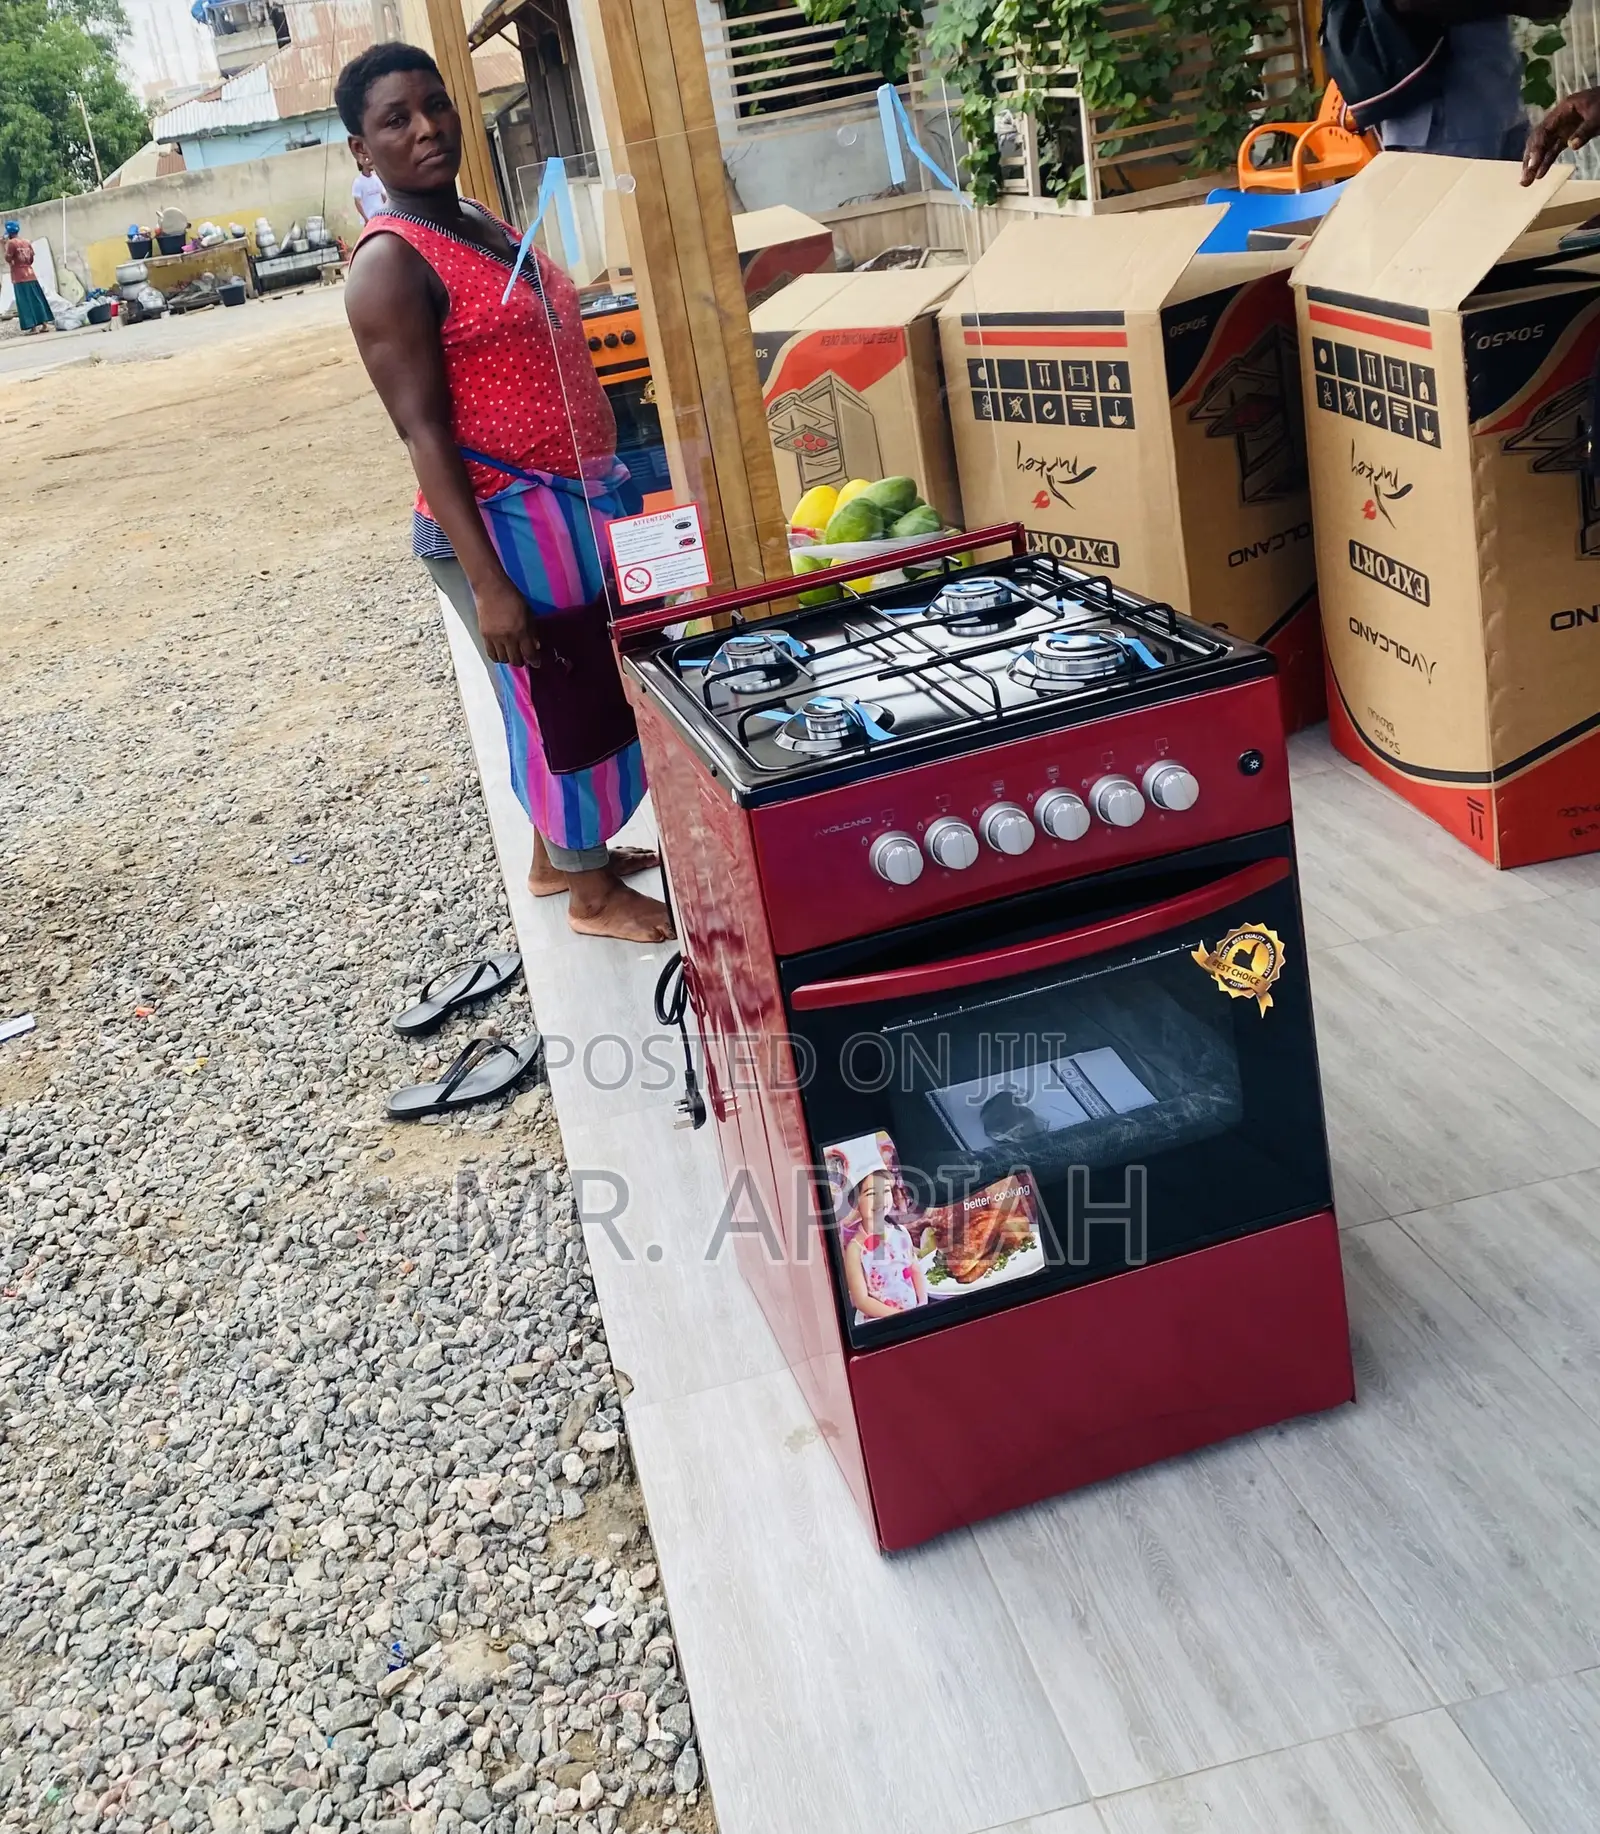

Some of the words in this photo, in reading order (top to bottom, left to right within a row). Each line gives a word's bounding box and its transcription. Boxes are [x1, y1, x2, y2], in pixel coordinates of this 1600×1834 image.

[1477, 323, 1546, 350] 50x50
[632, 512, 675, 527] ATTENTION!
[1227, 522, 1311, 568] OLCANO
[1352, 543, 1428, 604] EXPORT
[1349, 616, 1424, 672] VOLCANO
[822, 816, 872, 834] VOLCANO
[1244, 933, 1266, 942] QUALITY
[1212, 959, 1231, 973] BEST
[1231, 968, 1261, 987] CHOICE
[963, 1195, 990, 1211] better
[993, 1184, 1031, 1203] cooking
